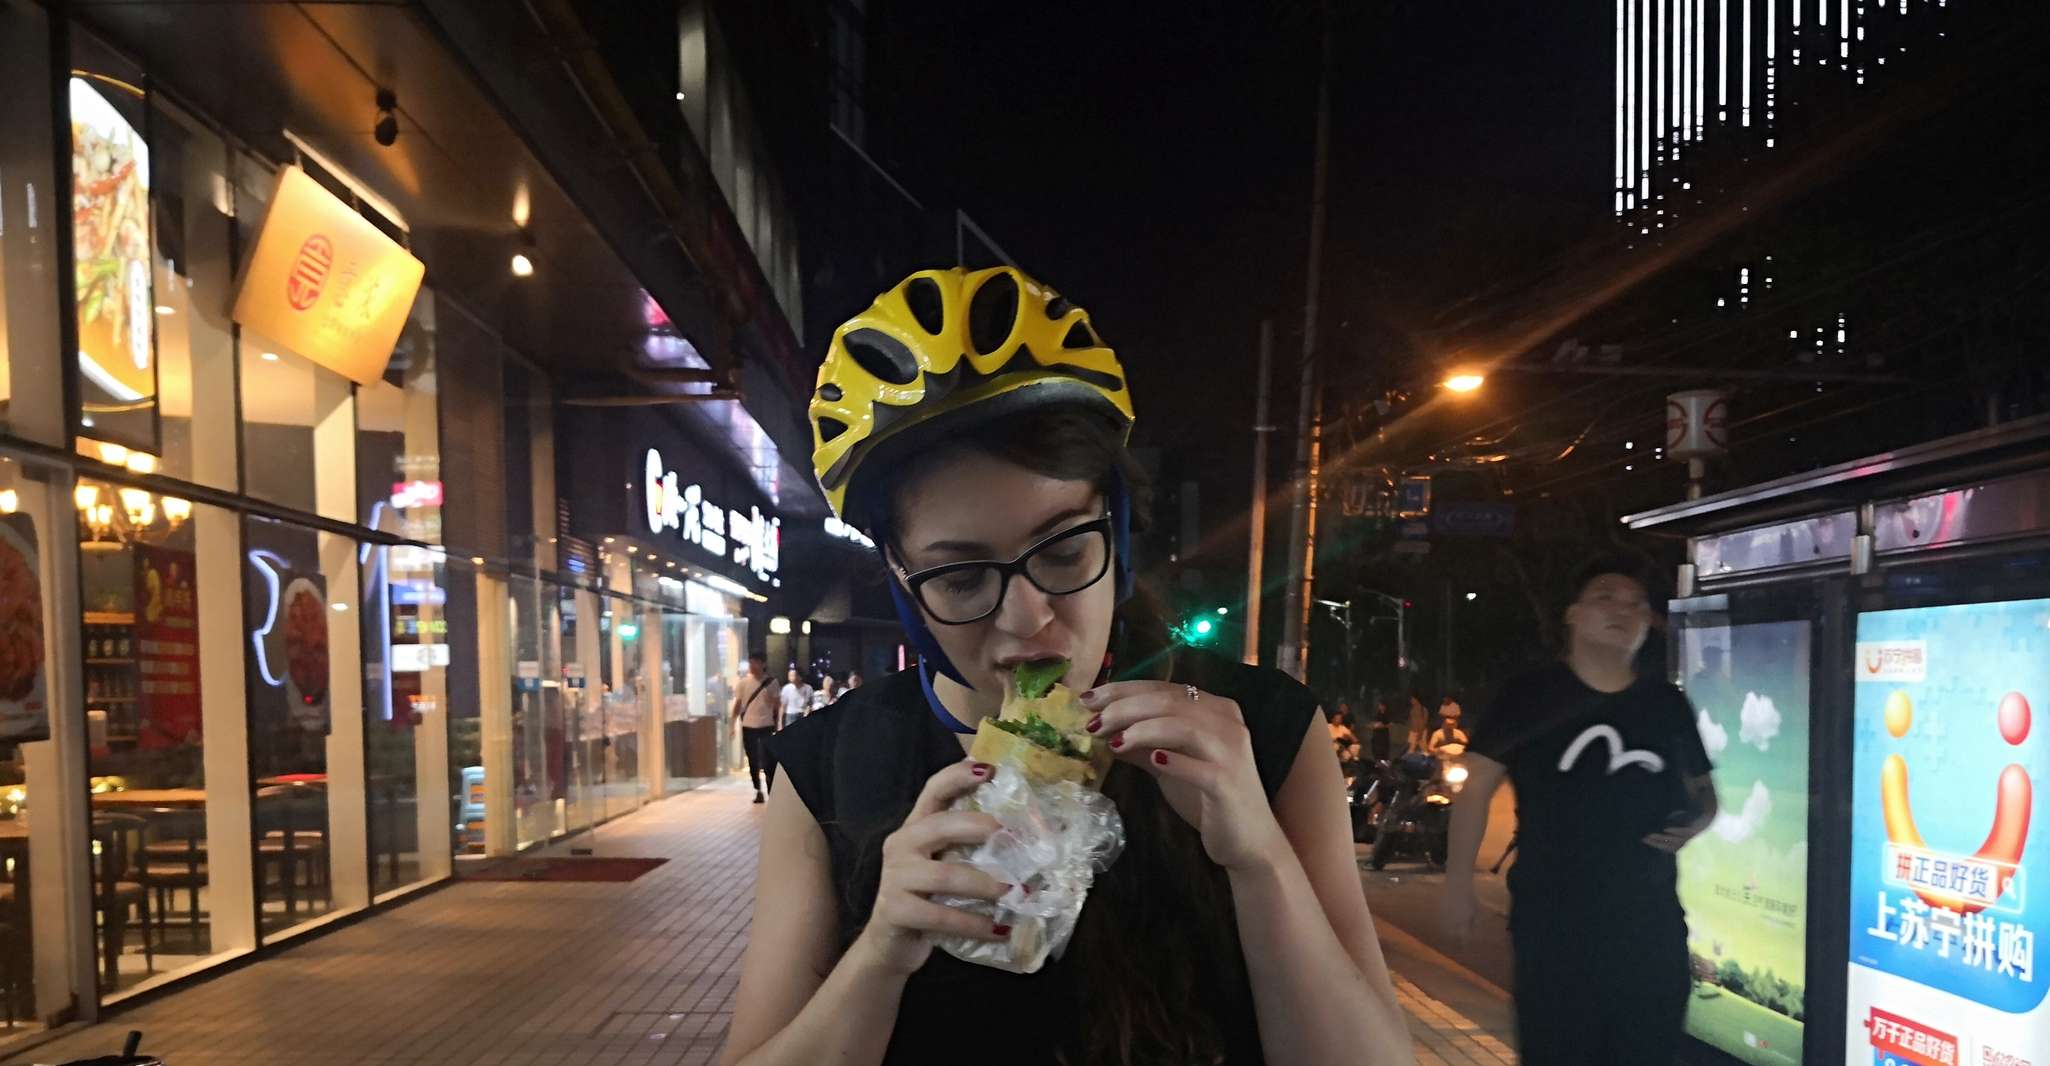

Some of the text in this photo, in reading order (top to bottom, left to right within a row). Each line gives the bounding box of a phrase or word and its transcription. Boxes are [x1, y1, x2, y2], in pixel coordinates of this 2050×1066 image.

[1896, 853, 1989, 898] 拼正品好货
[1867, 891, 2034, 982] 上苏宁拼购
